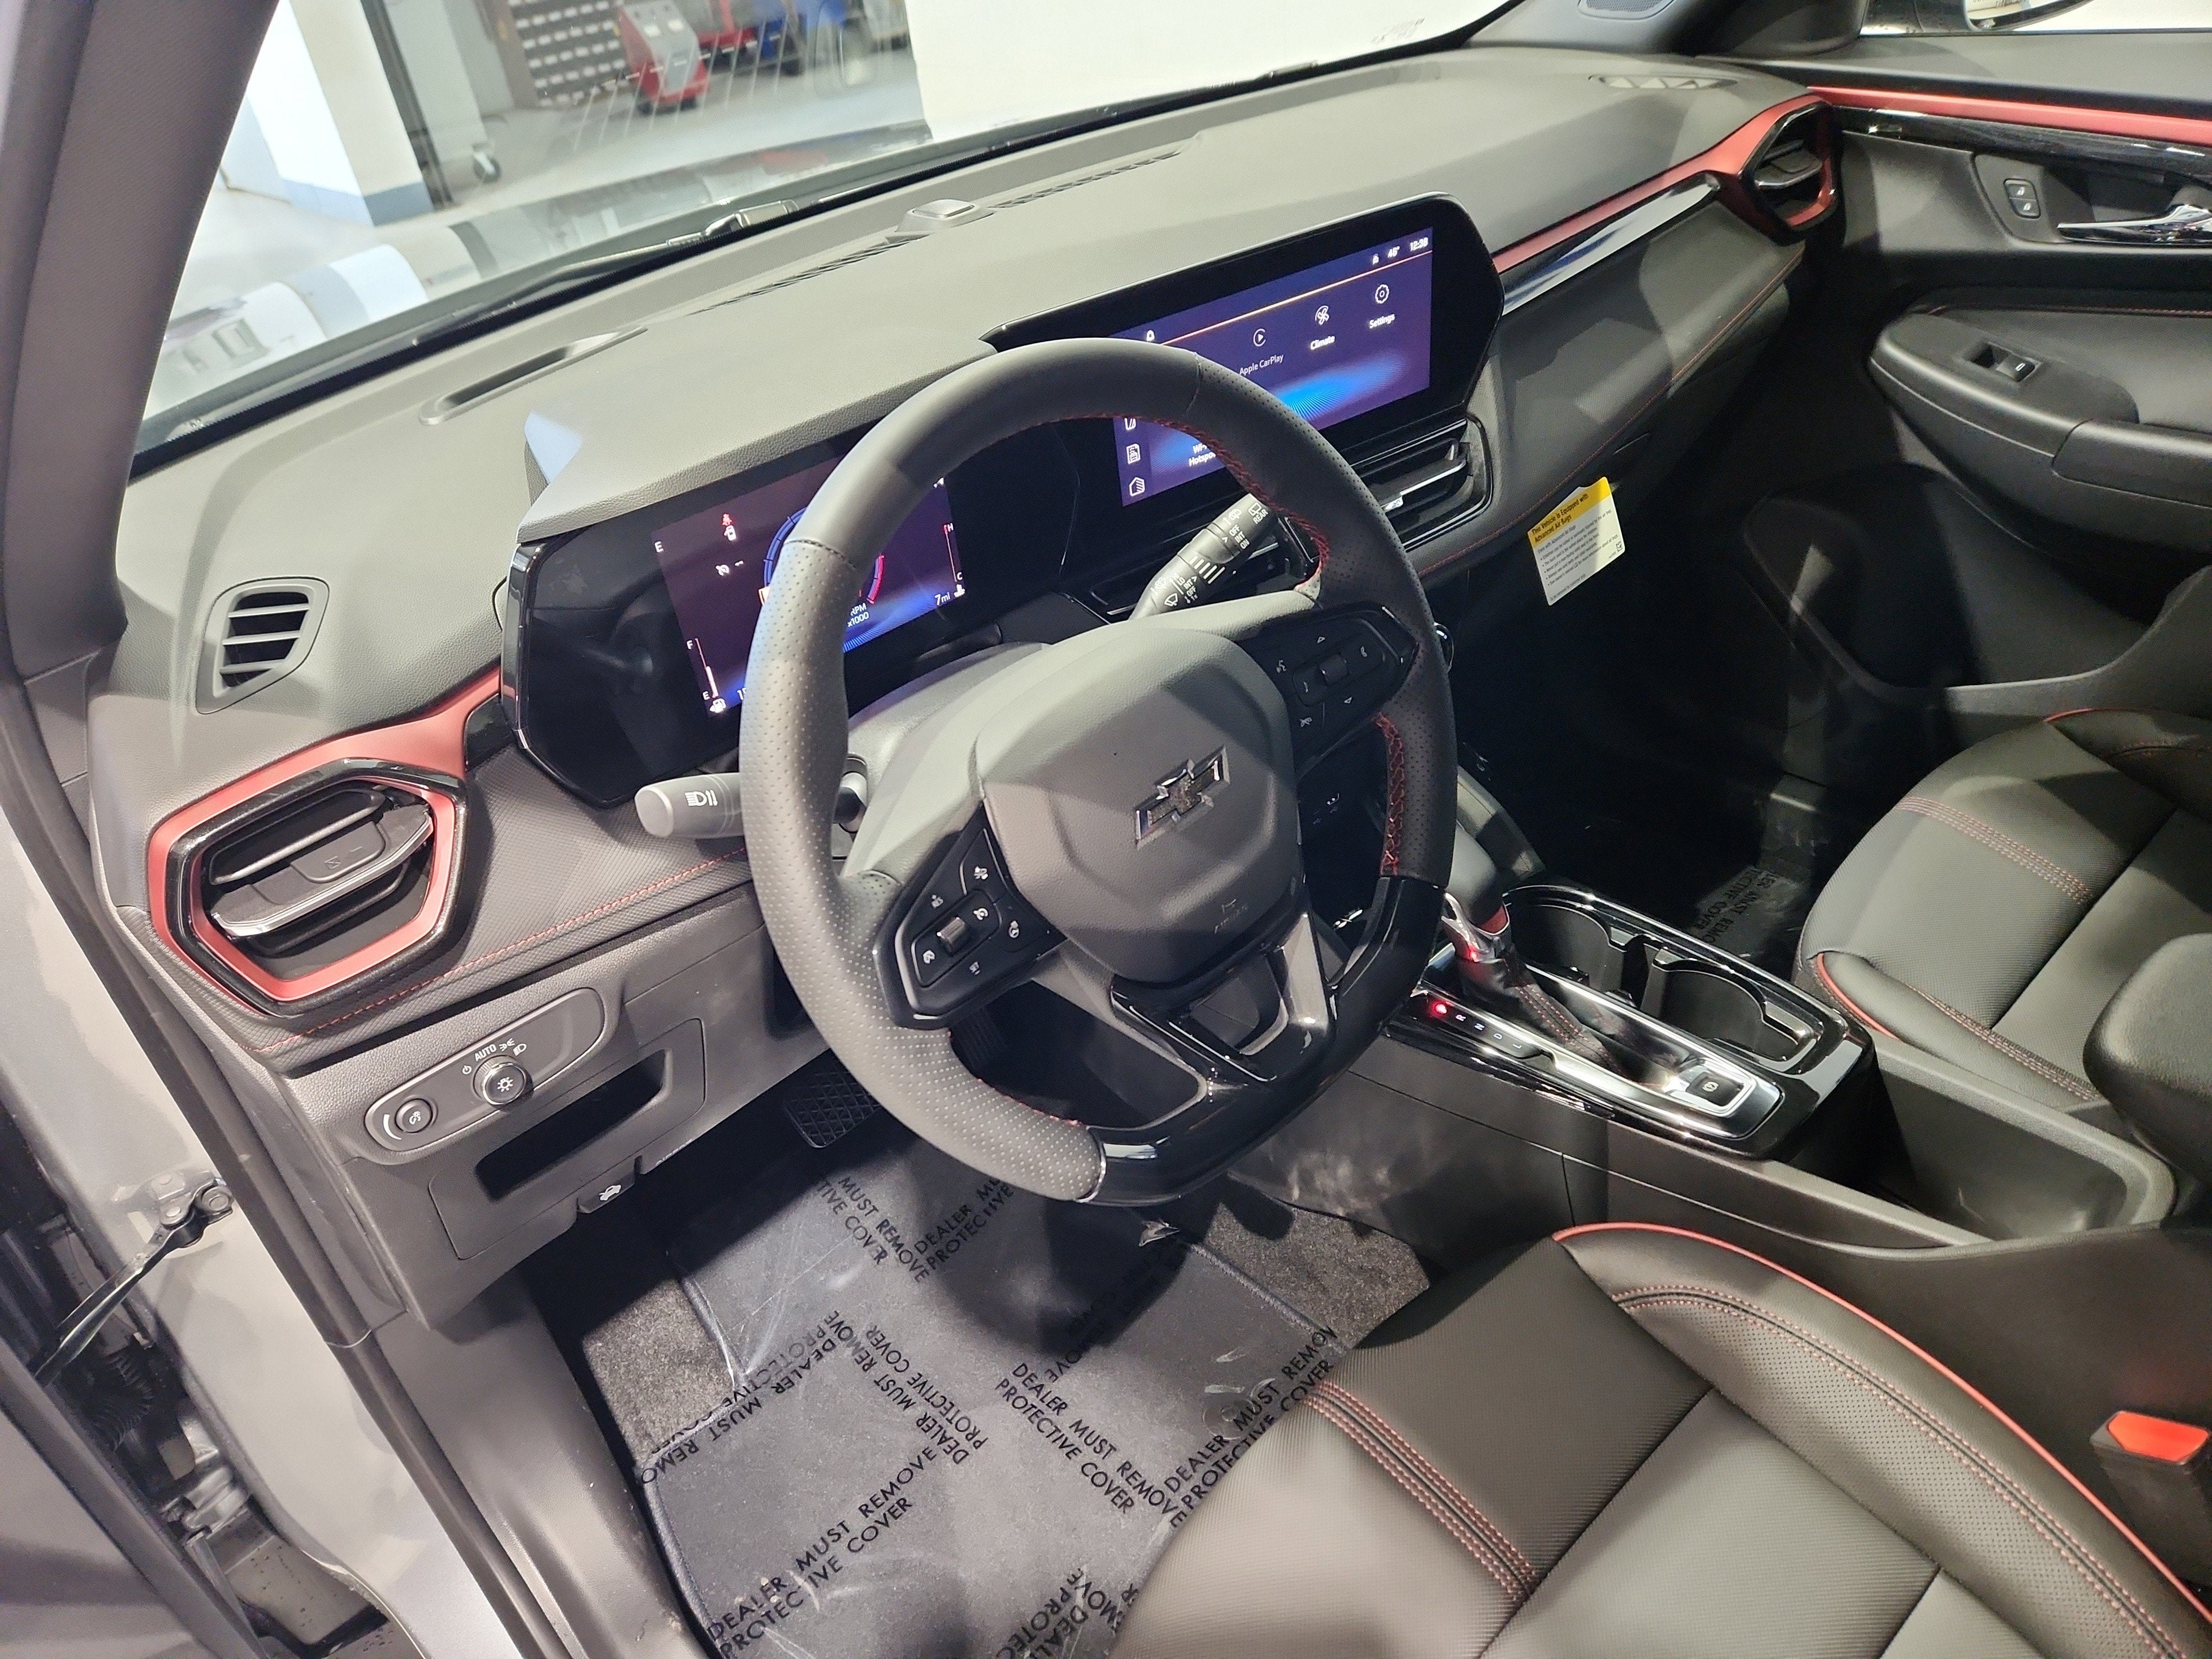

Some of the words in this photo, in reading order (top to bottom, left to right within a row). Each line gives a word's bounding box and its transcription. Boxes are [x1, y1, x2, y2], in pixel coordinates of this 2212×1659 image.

[1369, 313, 1396, 329] Settings
[1310, 336, 1335, 350] Climate
[1239, 363, 1258, 376] Apple
[1259, 355, 1284, 368] CarPlay
[1189, 452, 1216, 466] Hotspo
[947, 523, 954, 531] H
[1253, 509, 1268, 524] REAR
[1229, 525, 1240, 536] OFF
[1234, 531, 1245, 543] INT
[654, 541, 664, 552] E
[1240, 539, 1250, 549] ON
[1176, 577, 1185, 586] LO
[1184, 579, 1193, 589] INT
[1186, 586, 1196, 596] OFF
[847, 612, 869, 627] x1000
[851, 602, 866, 616] RPM
[686, 640, 693, 650] F
[703, 691, 710, 700] E
[474, 1044, 497, 1061] AUTO
[838, 1176, 879, 1217] MUST
[876, 1219, 930, 1283] REMOVE
[915, 1204, 972, 1255] DEALER
[926, 1182, 1013, 1270] PROTECTIVE
[824, 1310, 877, 1373] REMOVE
[866, 1325, 909, 1373] COVER
[771, 1339, 836, 1394] DEALER
[873, 1374, 916, 1411] MUST
[709, 1397, 762, 1441] MUST
[906, 1372, 988, 1450] PROTECTIVE
[1164, 1435, 1229, 1494] DEALER
[1233, 1382, 1280, 1431] MUST
[1281, 1325, 1338, 1380] REMOV
[916, 1412, 970, 1464] DEALER
[1012, 1363, 1068, 1416] DEALER
[1069, 1419, 1117, 1459] MUST
[1117, 1461, 1187, 1528] REMOVE
[1181, 1414, 1275, 1510] PROTECTIVE
[1281, 1360, 1334, 1411] COVER
[995, 1378, 1082, 1459] PROTECTIVE
[1081, 1462, 1135, 1514] COVER
[641, 1439, 699, 1483] REMO
[708, 1576, 787, 1641] DEALER
[795, 1520, 850, 1572] MUST
[858, 1446, 937, 1518] REMOVE
[719, 1555, 843, 1659] PROTECIVE
[847, 1497, 912, 1553] COVER
